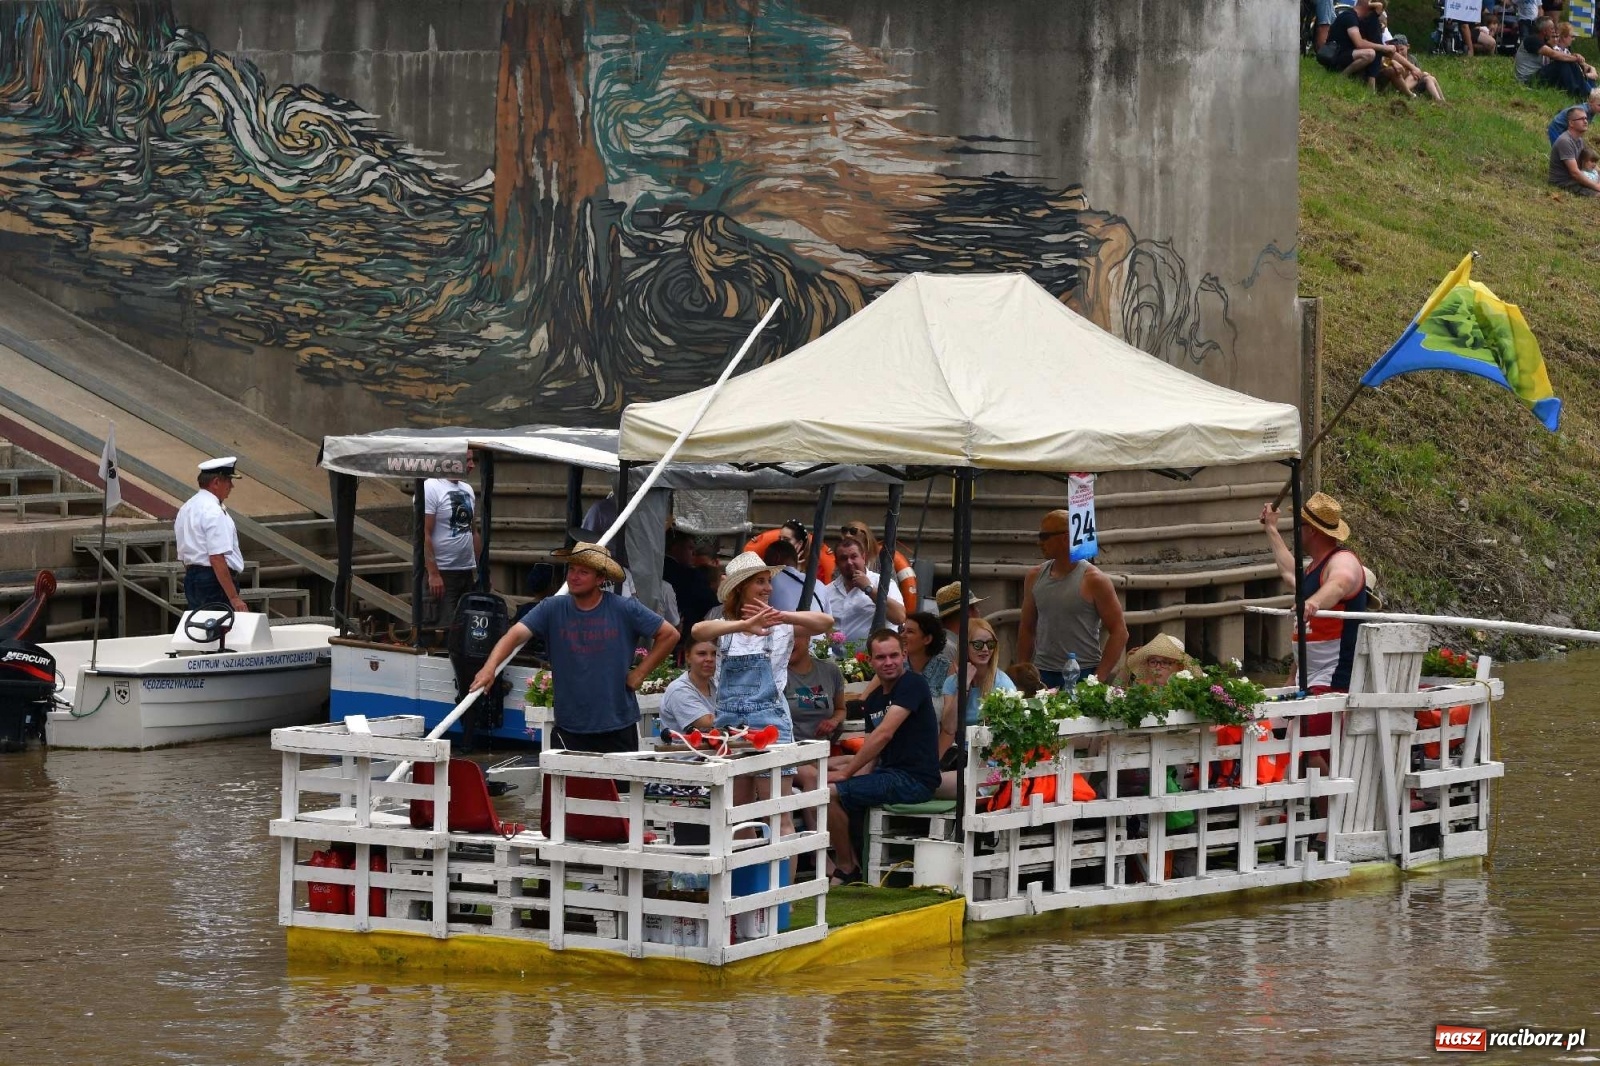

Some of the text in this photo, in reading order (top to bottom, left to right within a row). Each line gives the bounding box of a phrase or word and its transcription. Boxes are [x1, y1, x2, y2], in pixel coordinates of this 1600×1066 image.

[1072, 510, 1095, 546] 24
[471, 615, 489, 629] 30
[1, 651, 51, 666] MERCURY
[187, 659, 220, 670] CENTRUM
